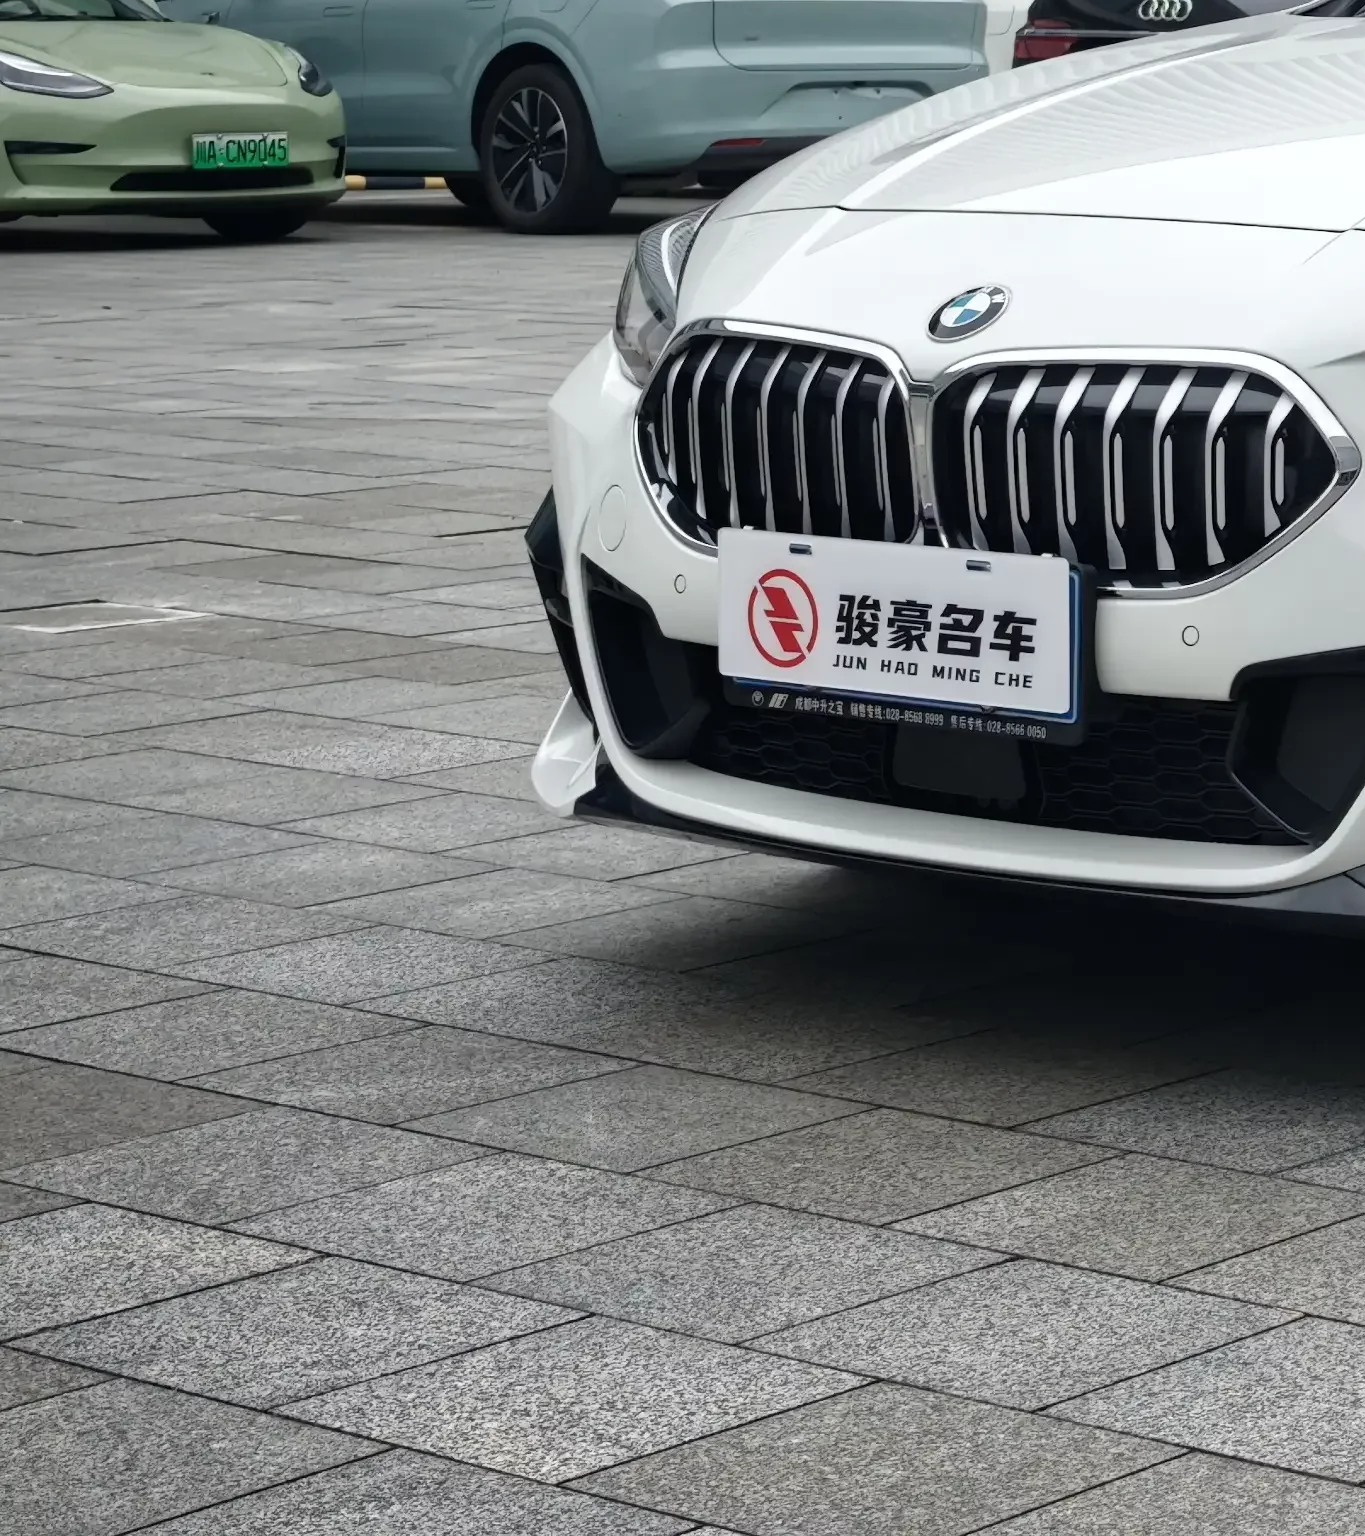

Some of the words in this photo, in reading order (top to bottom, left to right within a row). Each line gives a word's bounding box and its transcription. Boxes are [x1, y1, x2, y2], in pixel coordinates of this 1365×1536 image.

[835, 594, 1038, 662] 骏豪名车
[832, 654, 867, 671] JUN
[880, 659, 918, 676] HAO
[932, 664, 981, 683] MING
[994, 671, 1034, 689] CHE
